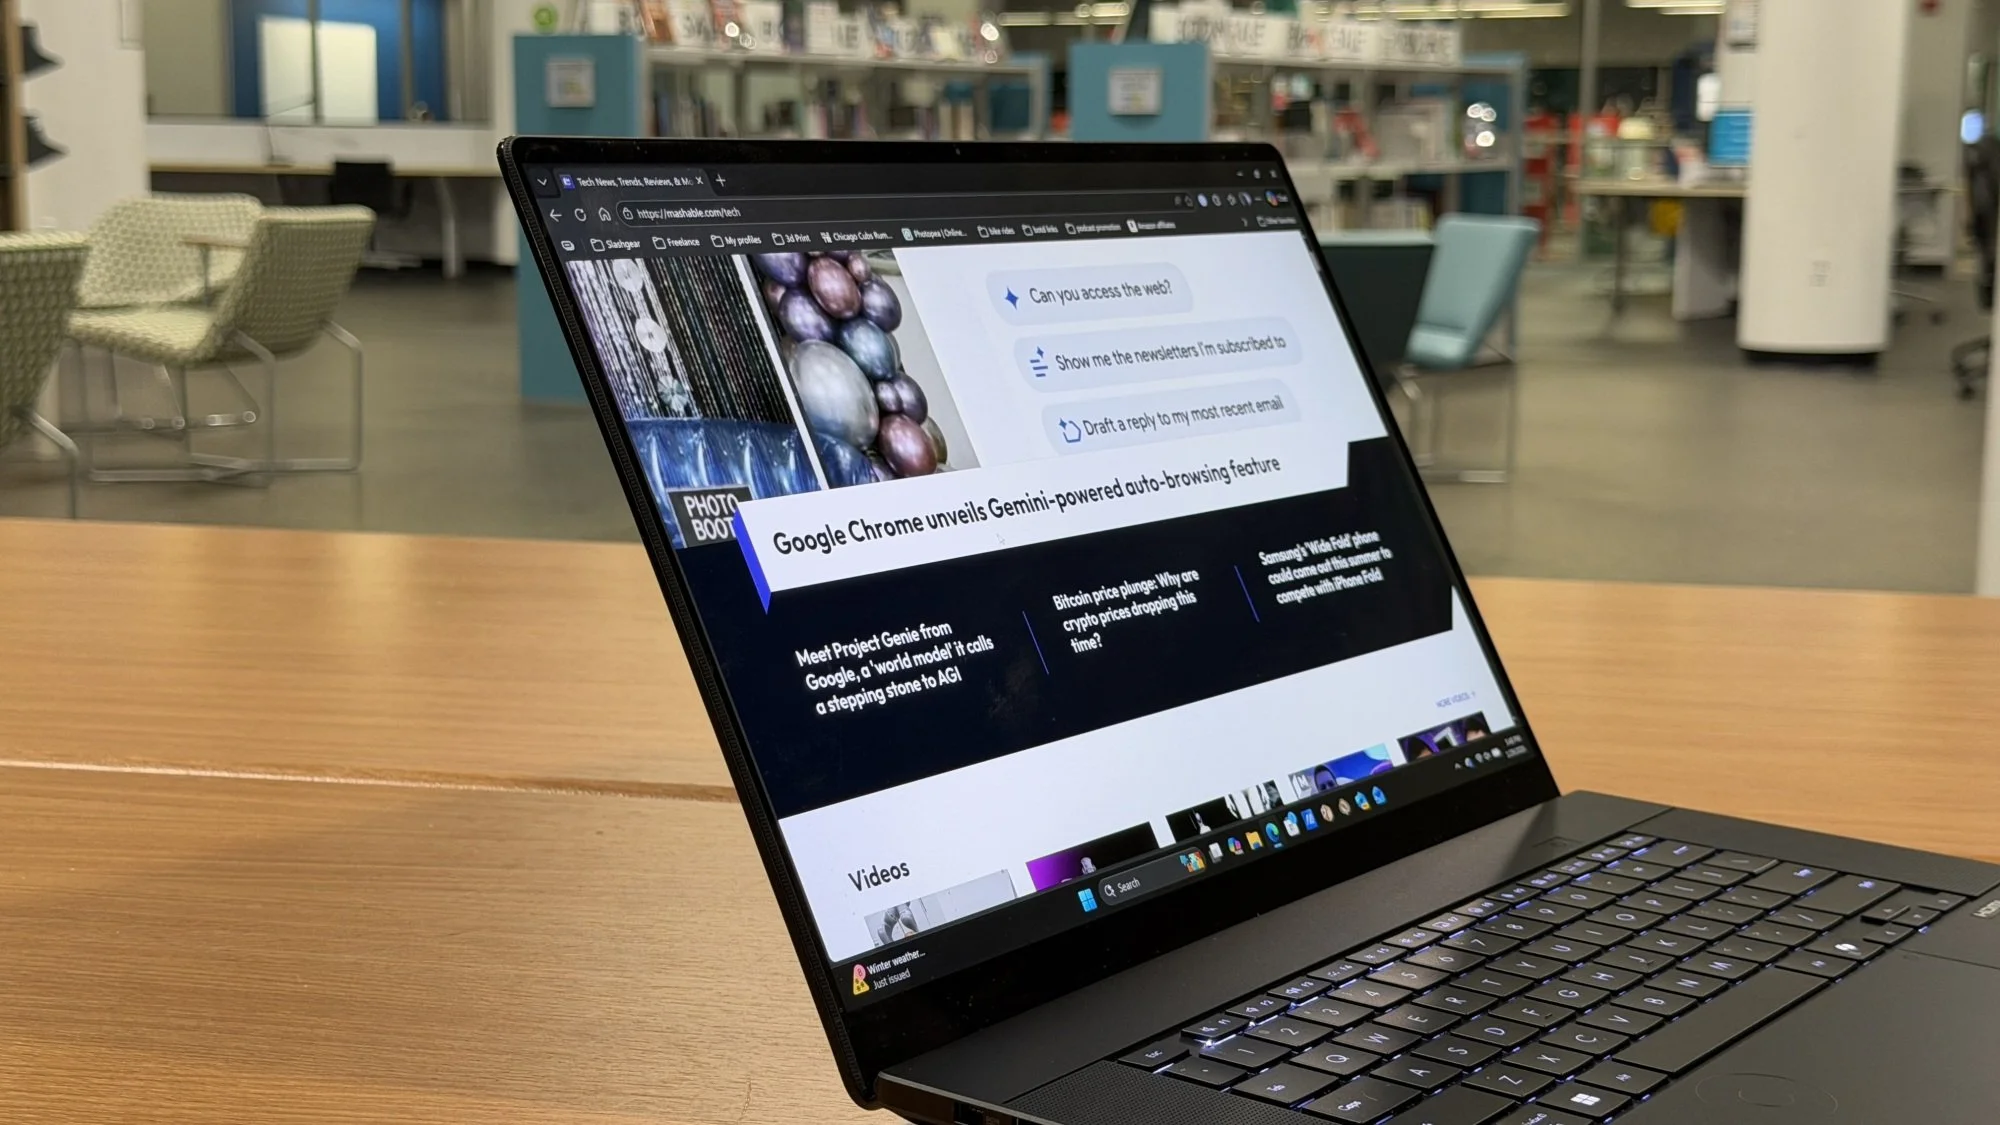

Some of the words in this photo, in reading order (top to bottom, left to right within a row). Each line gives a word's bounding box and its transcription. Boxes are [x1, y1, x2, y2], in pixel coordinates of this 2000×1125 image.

[577, 177, 594, 187] Tech
[595, 177, 618, 188] News,
[618, 177, 644, 187] Trends,
[644, 177, 674, 187] Reviews,
[675, 177, 681, 186] &
[637, 206, 741, 220] https://mashable.com/tech
[795, 234, 811, 242] Print
[833, 233, 858, 243] Chicago
[858, 232, 873, 241] Cubs
[913, 230, 941, 239] Photopea
[606, 239, 640, 250] Slashgear
[667, 237, 700, 247] Freelance
[725, 236, 736, 247] My
[737, 235, 762, 246] profiles
[1029, 288, 1056, 304] Can
[1056, 288, 1080, 306] you
[1080, 285, 1121, 300] access
[1122, 282, 1142, 297] the
[1143, 279, 1173, 296] web?
[1055, 355, 1090, 372] Show
[1092, 353, 1111, 367] me
[1112, 350, 1133, 365] the
[1134, 343, 1199, 363] newsletters
[1199, 341, 1217, 357] I'm
[1217, 335, 1273, 354] subscribed
[1273, 336, 1286, 349] to
[1083, 417, 1116, 437] Draft
[1118, 419, 1127, 432] a
[1127, 413, 1157, 433] reply
[1158, 412, 1171, 426] to
[1172, 410, 1189, 427] my
[1191, 405, 1220, 421] most
[1220, 401, 1256, 418] recent
[1255, 396, 1284, 413] email
[683, 493, 739, 518] PHOTO
[773, 524, 847, 555] Google
[848, 516, 924, 543] Chrome
[925, 500, 988, 530] unveils
[988, 478, 1124, 519] Gemini-powered
[1126, 463, 1231, 496] auto-browsing
[1229, 457, 1281, 479] feature
[1258, 544, 1308, 566] Samsung's
[1352, 531, 1381, 549] phone
[1268, 567, 1294, 585] could
[1293, 566, 1318, 580] come
[1317, 559, 1334, 574] out
[1332, 556, 1350, 571] this
[1348, 550, 1383, 567] summer
[1381, 546, 1394, 560] to
[1053, 590, 1093, 611] Bitcoin
[1092, 585, 1120, 606] price
[1119, 580, 1158, 600] plunge:
[1155, 571, 1182, 588] Why
[1181, 569, 1200, 583] are
[1276, 584, 1316, 604] compete
[1314, 579, 1334, 596] with
[1333, 573, 1364, 591] iPhone
[1361, 567, 1384, 584] Fold
[1063, 612, 1099, 633] crypto
[1098, 607, 1132, 627] prices
[1131, 596, 1179, 616] dropping
[1176, 590, 1197, 605] this
[795, 645, 832, 667] Meet
[831, 634, 881, 659] Project
[881, 627, 920, 648] Genie
[920, 622, 952, 640] from
[1070, 632, 1103, 653] time?
[805, 666, 861, 690] Google,
[861, 667, 871, 679] a
[869, 652, 912, 675] 'world
[913, 642, 953, 666] model'
[953, 640, 966, 657] it
[967, 634, 994, 654] calls
[816, 703, 827, 715] a
[827, 687, 886, 713] stepping
[886, 681, 922, 698] stone
[922, 673, 937, 689] to
[937, 665, 962, 687] AGI
[848, 862, 910, 892] Videos
[1117, 877, 1141, 893] Search
[1470, 938, 1486, 947] 7
[1656, 939, 1678, 947] K
[1550, 944, 1572, 952] U
[867, 957, 892, 975] Winter
[892, 949, 926, 967] weather...
[1628, 955, 1647, 963] J
[1516, 961, 1537, 969] Y
[1708, 961, 1733, 971] M
[873, 976, 888, 990] Just
[888, 969, 911, 986] issued
[1401, 971, 1418, 979] 5
[1591, 972, 1615, 981] H
[1481, 978, 1502, 986] T
[1675, 978, 1700, 988] N
[1558, 989, 1580, 998] G
[1445, 997, 1467, 1005] R
[1643, 997, 1666, 1005] B
[1322, 1008, 1340, 1016] 3
[1521, 1007, 1540, 1017] F
[1407, 1014, 1428, 1023] E
[1607, 1015, 1631, 1024] V
[1280, 1027, 1299, 1036] 2
[1484, 1027, 1505, 1036] D
[1363, 1032, 1390, 1044] W
[1575, 1034, 1597, 1043] C
[1447, 1046, 1468, 1055] S
[1326, 1054, 1350, 1063] Q
[1536, 1054, 1561, 1064] X
[1408, 1067, 1431, 1077] A
[1498, 1074, 1523, 1086] Z
